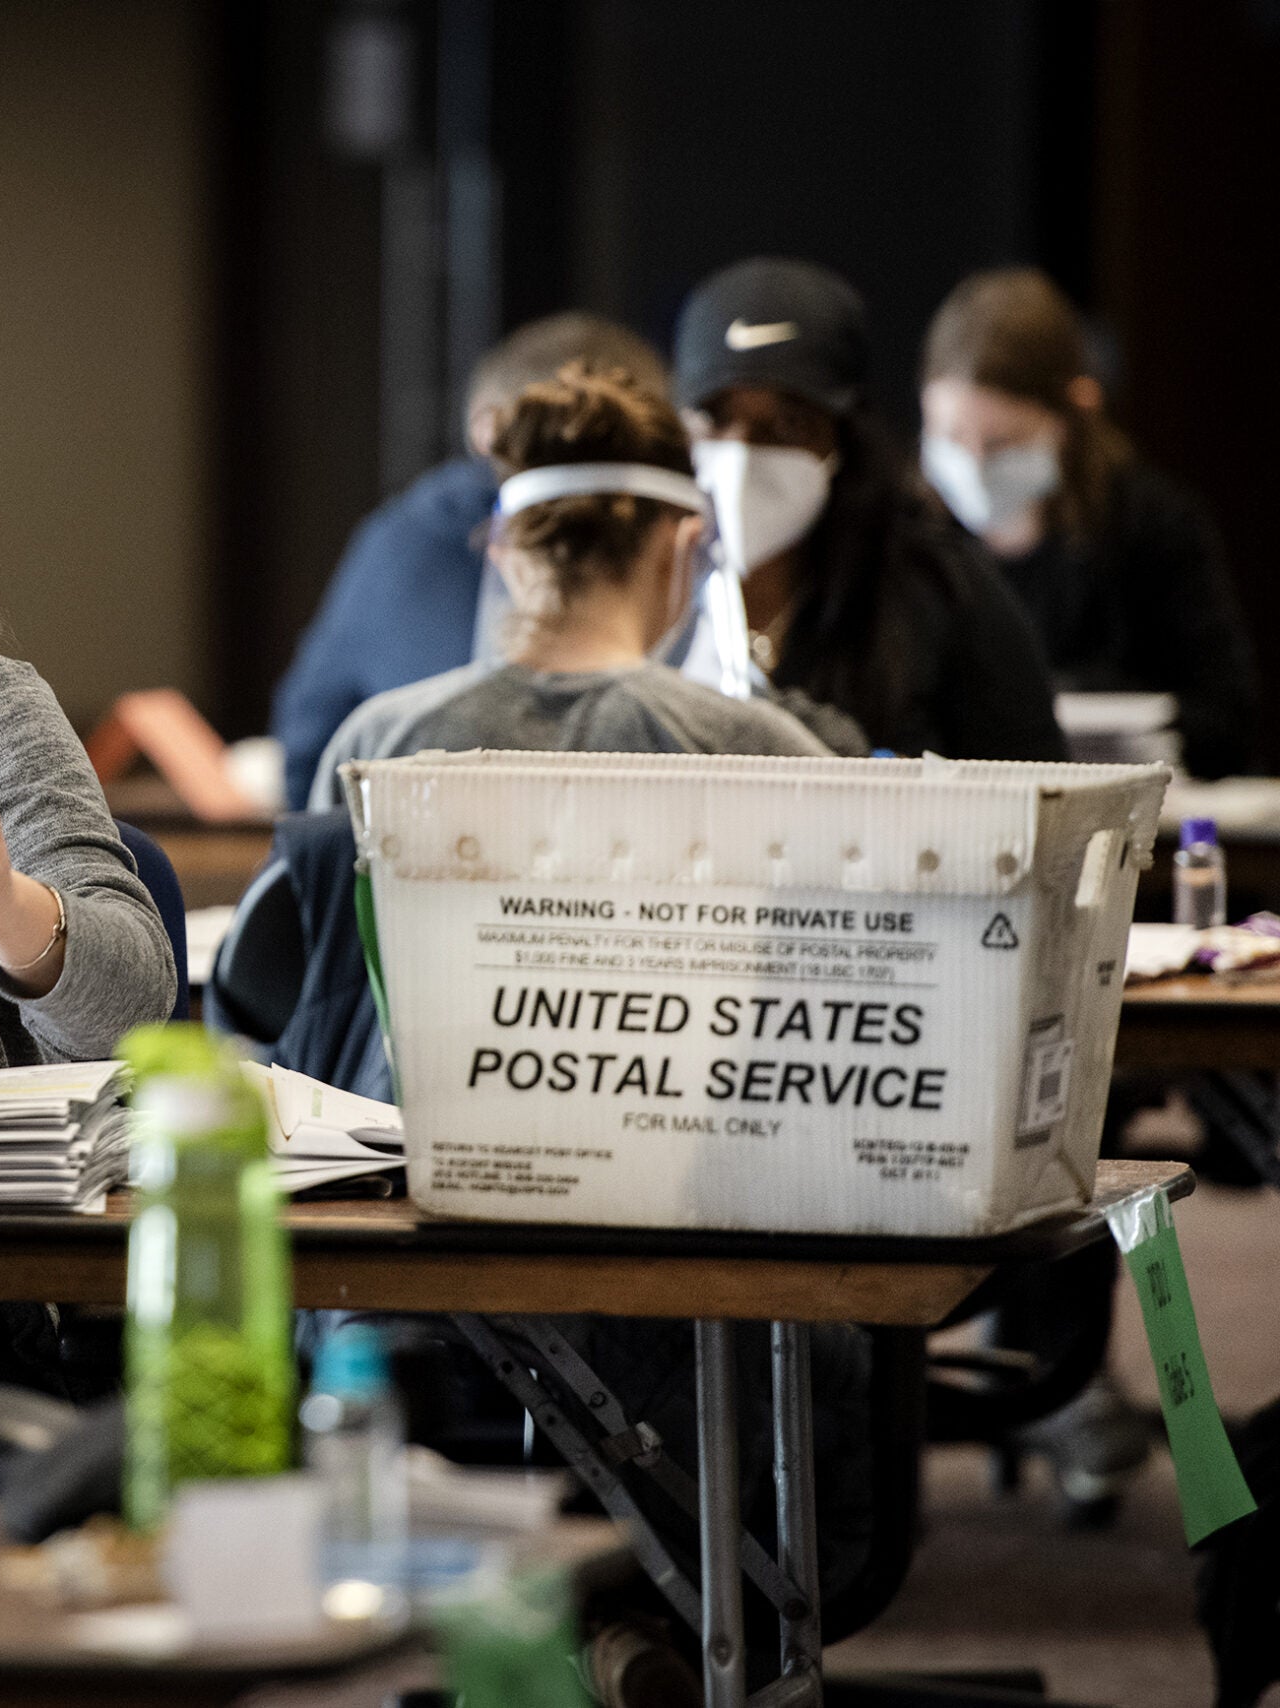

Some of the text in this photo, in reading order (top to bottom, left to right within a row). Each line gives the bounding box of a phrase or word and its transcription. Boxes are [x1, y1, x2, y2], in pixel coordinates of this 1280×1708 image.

[500, 896, 616, 919] WARNING
[639, 902, 689, 922] NOT
[697, 904, 747, 925] FOR
[755, 906, 857, 931] PRIVATE
[864, 911, 915, 933] USE
[559, 951, 590, 966] FINE
[614, 934, 642, 948] FOR
[648, 937, 691, 950] THEFT
[776, 942, 795, 957] OF
[799, 943, 852, 959] POSTAL
[492, 986, 925, 1046] UNITED STATES
[467, 1048, 948, 1111] POSTAL SERVICE
[622, 1112, 783, 1138] FOR MAIL ONLY
